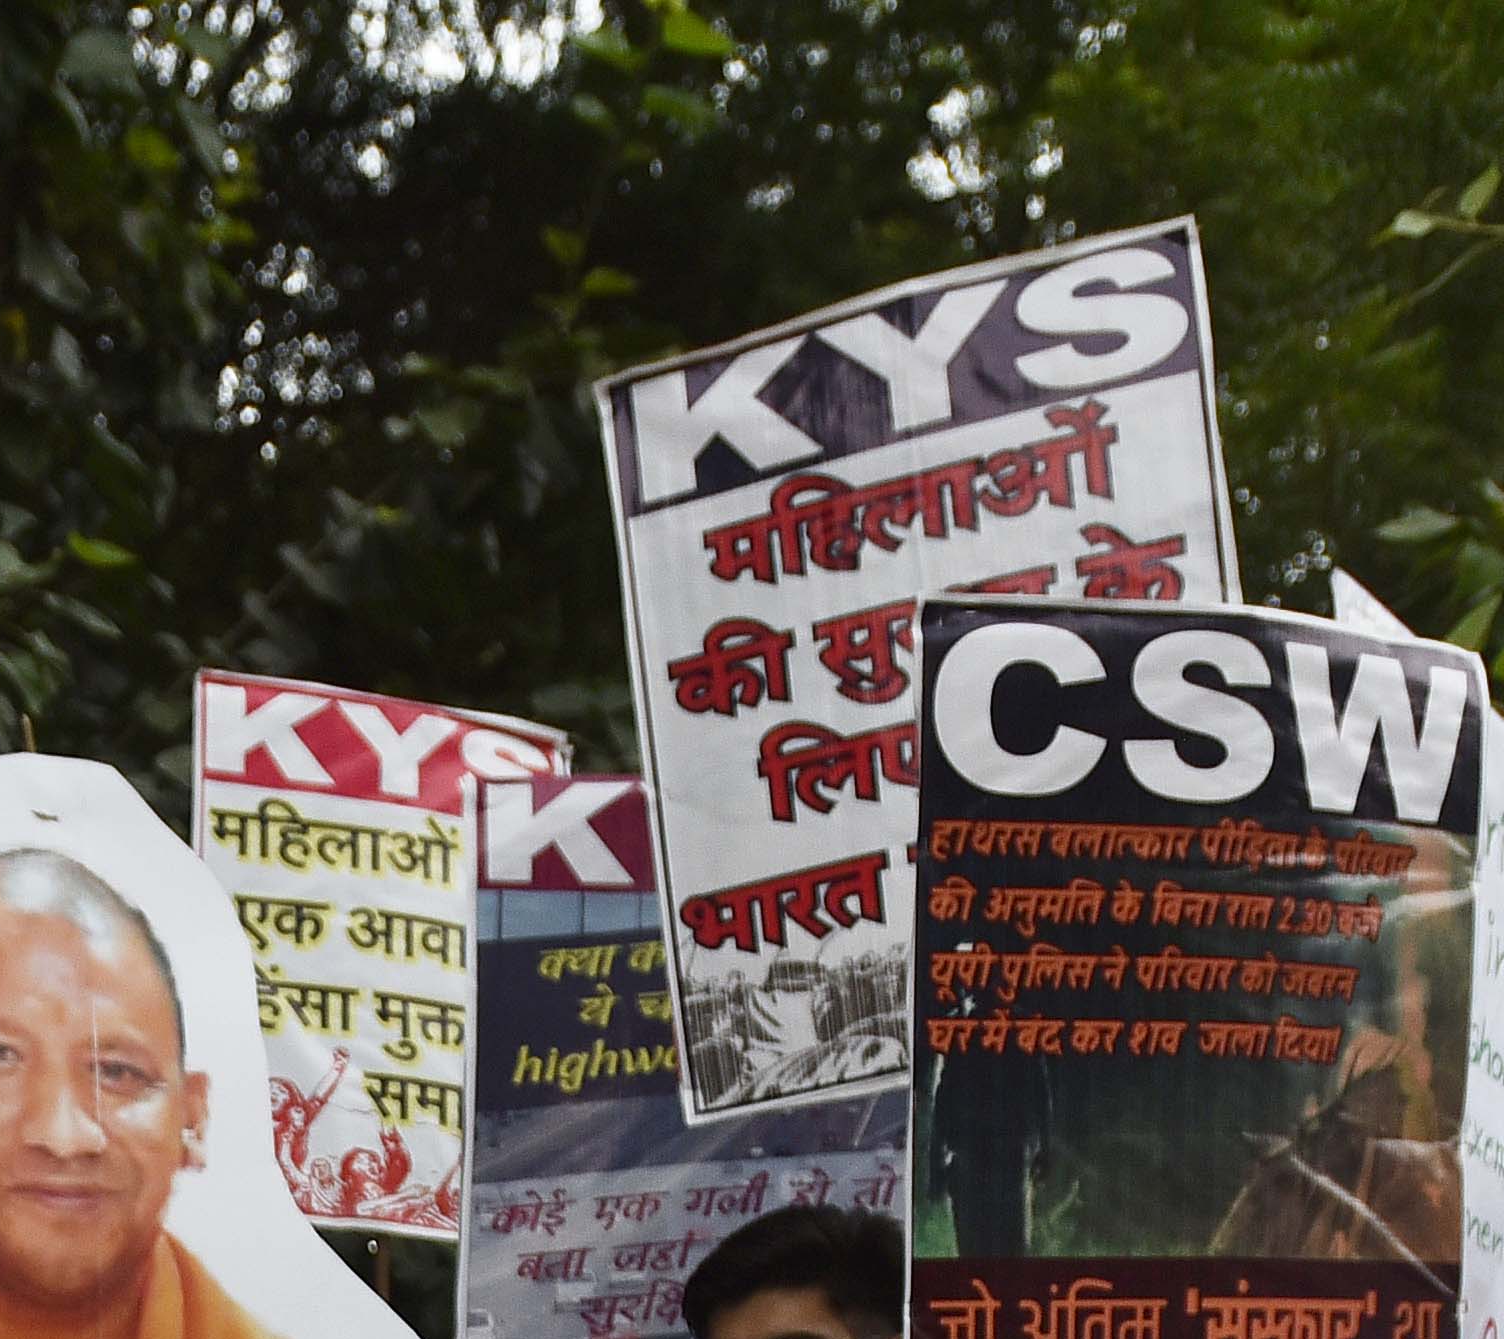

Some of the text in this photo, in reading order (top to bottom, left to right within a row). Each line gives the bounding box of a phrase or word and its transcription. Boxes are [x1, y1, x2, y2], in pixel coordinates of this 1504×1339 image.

[631, 248, 1189, 502] KYS
[703, 400, 1119, 584] महिलाओं
[667, 617, 796, 717] की
[934, 622, 1474, 822] CSW
[210, 797, 463, 885] महिलाओं
[233, 893, 332, 951] एक
[679, 847, 892, 954] भारत
[928, 874, 979, 922] की
[984, 877, 1107, 939] अनुमति
[1111, 878, 1146, 925] के
